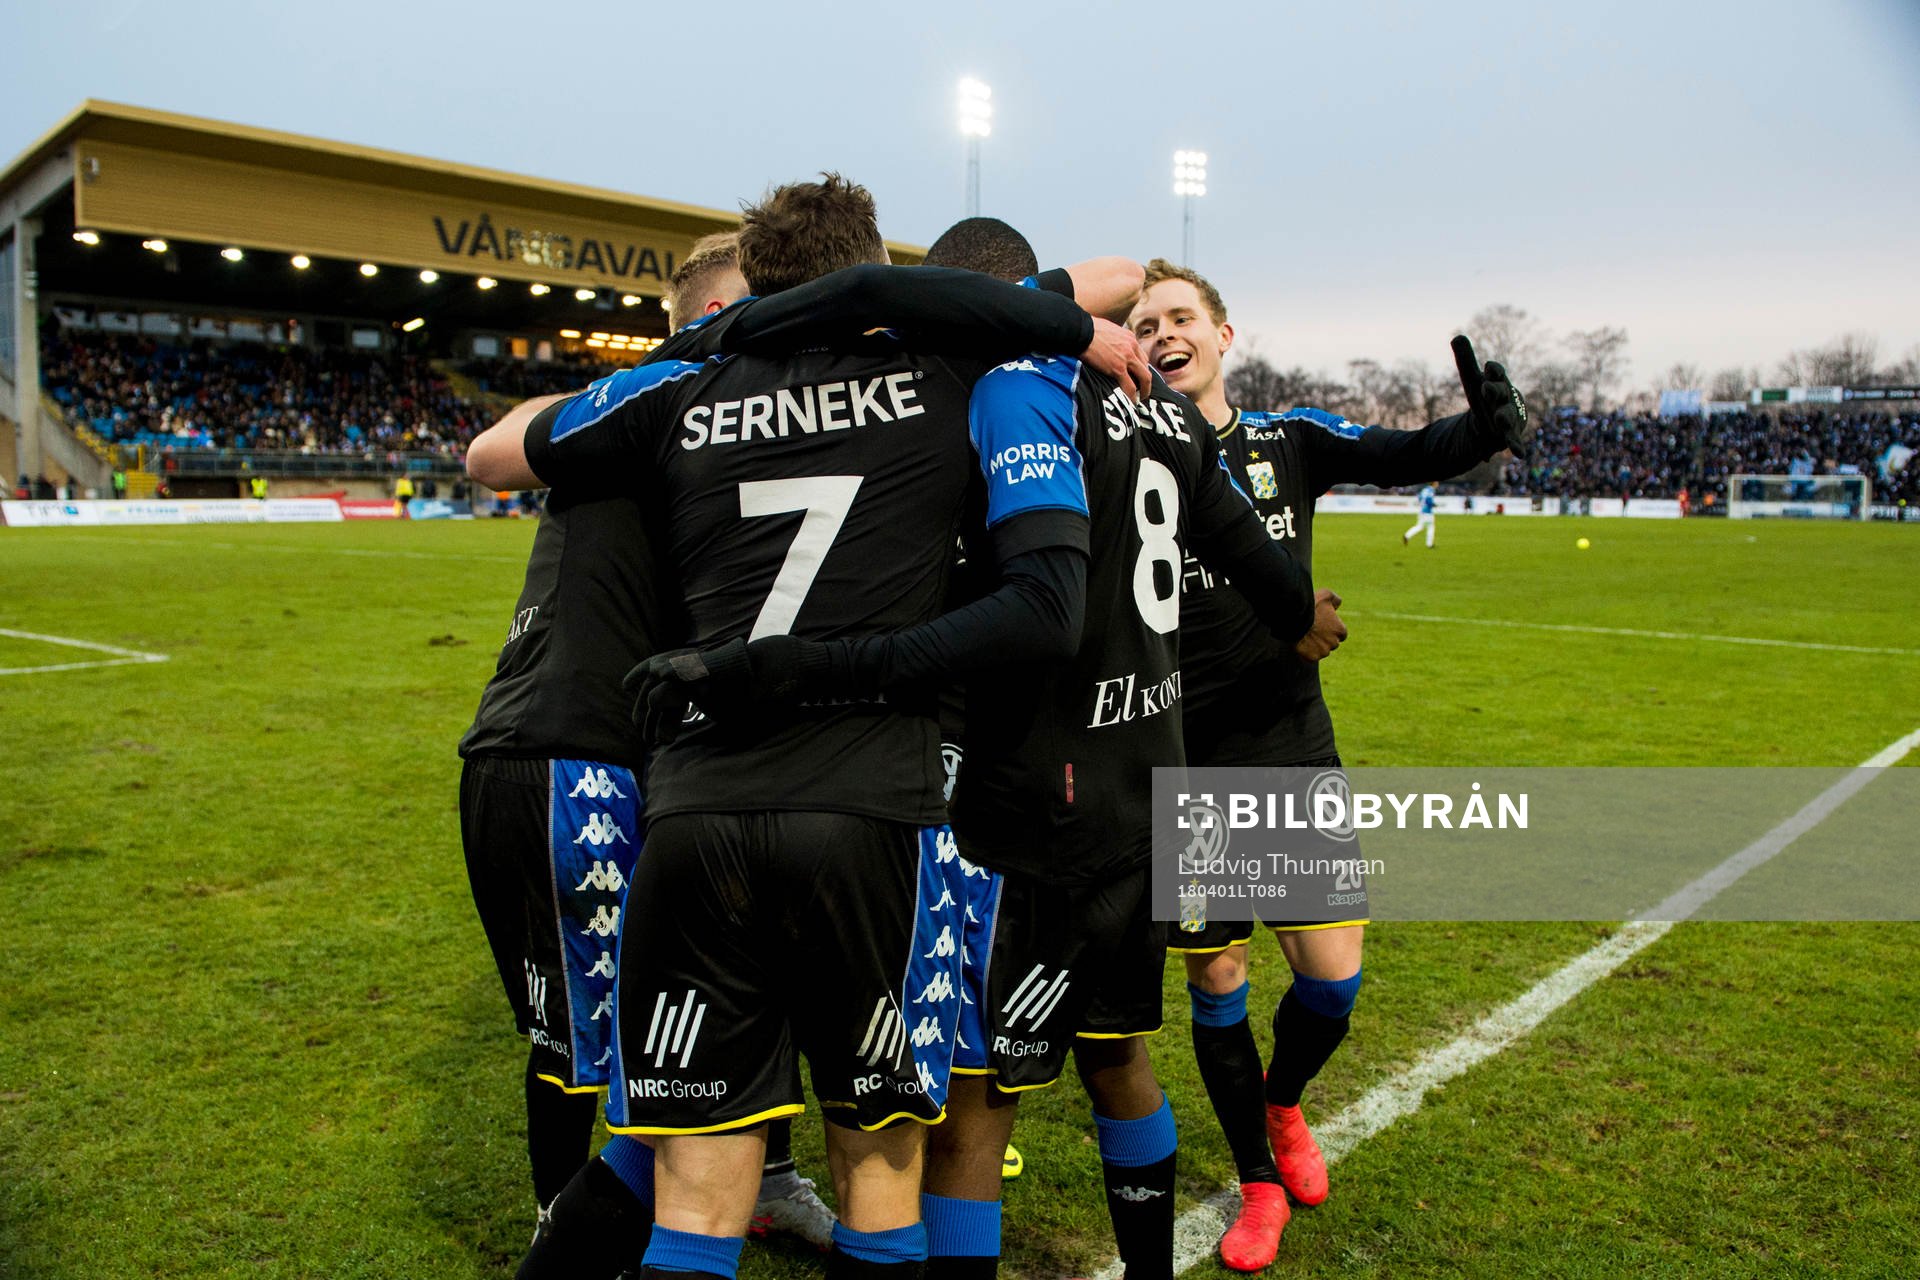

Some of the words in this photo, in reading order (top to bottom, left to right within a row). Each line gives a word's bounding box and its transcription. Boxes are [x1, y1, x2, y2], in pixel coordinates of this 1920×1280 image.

[681, 371, 926, 450] SERNEKE
[990, 443, 1071, 475] MORRIS
[1006, 462, 1055, 485] LAW
[739, 475, 865, 643] 7
[1133, 457, 1182, 635] 8
[1087, 672, 1136, 728] El
[1335, 858, 1362, 891] 20
[1327, 891, 1367, 906] Kappa
[629, 1079, 669, 1098] NRC
[671, 1079, 727, 1100] Group
